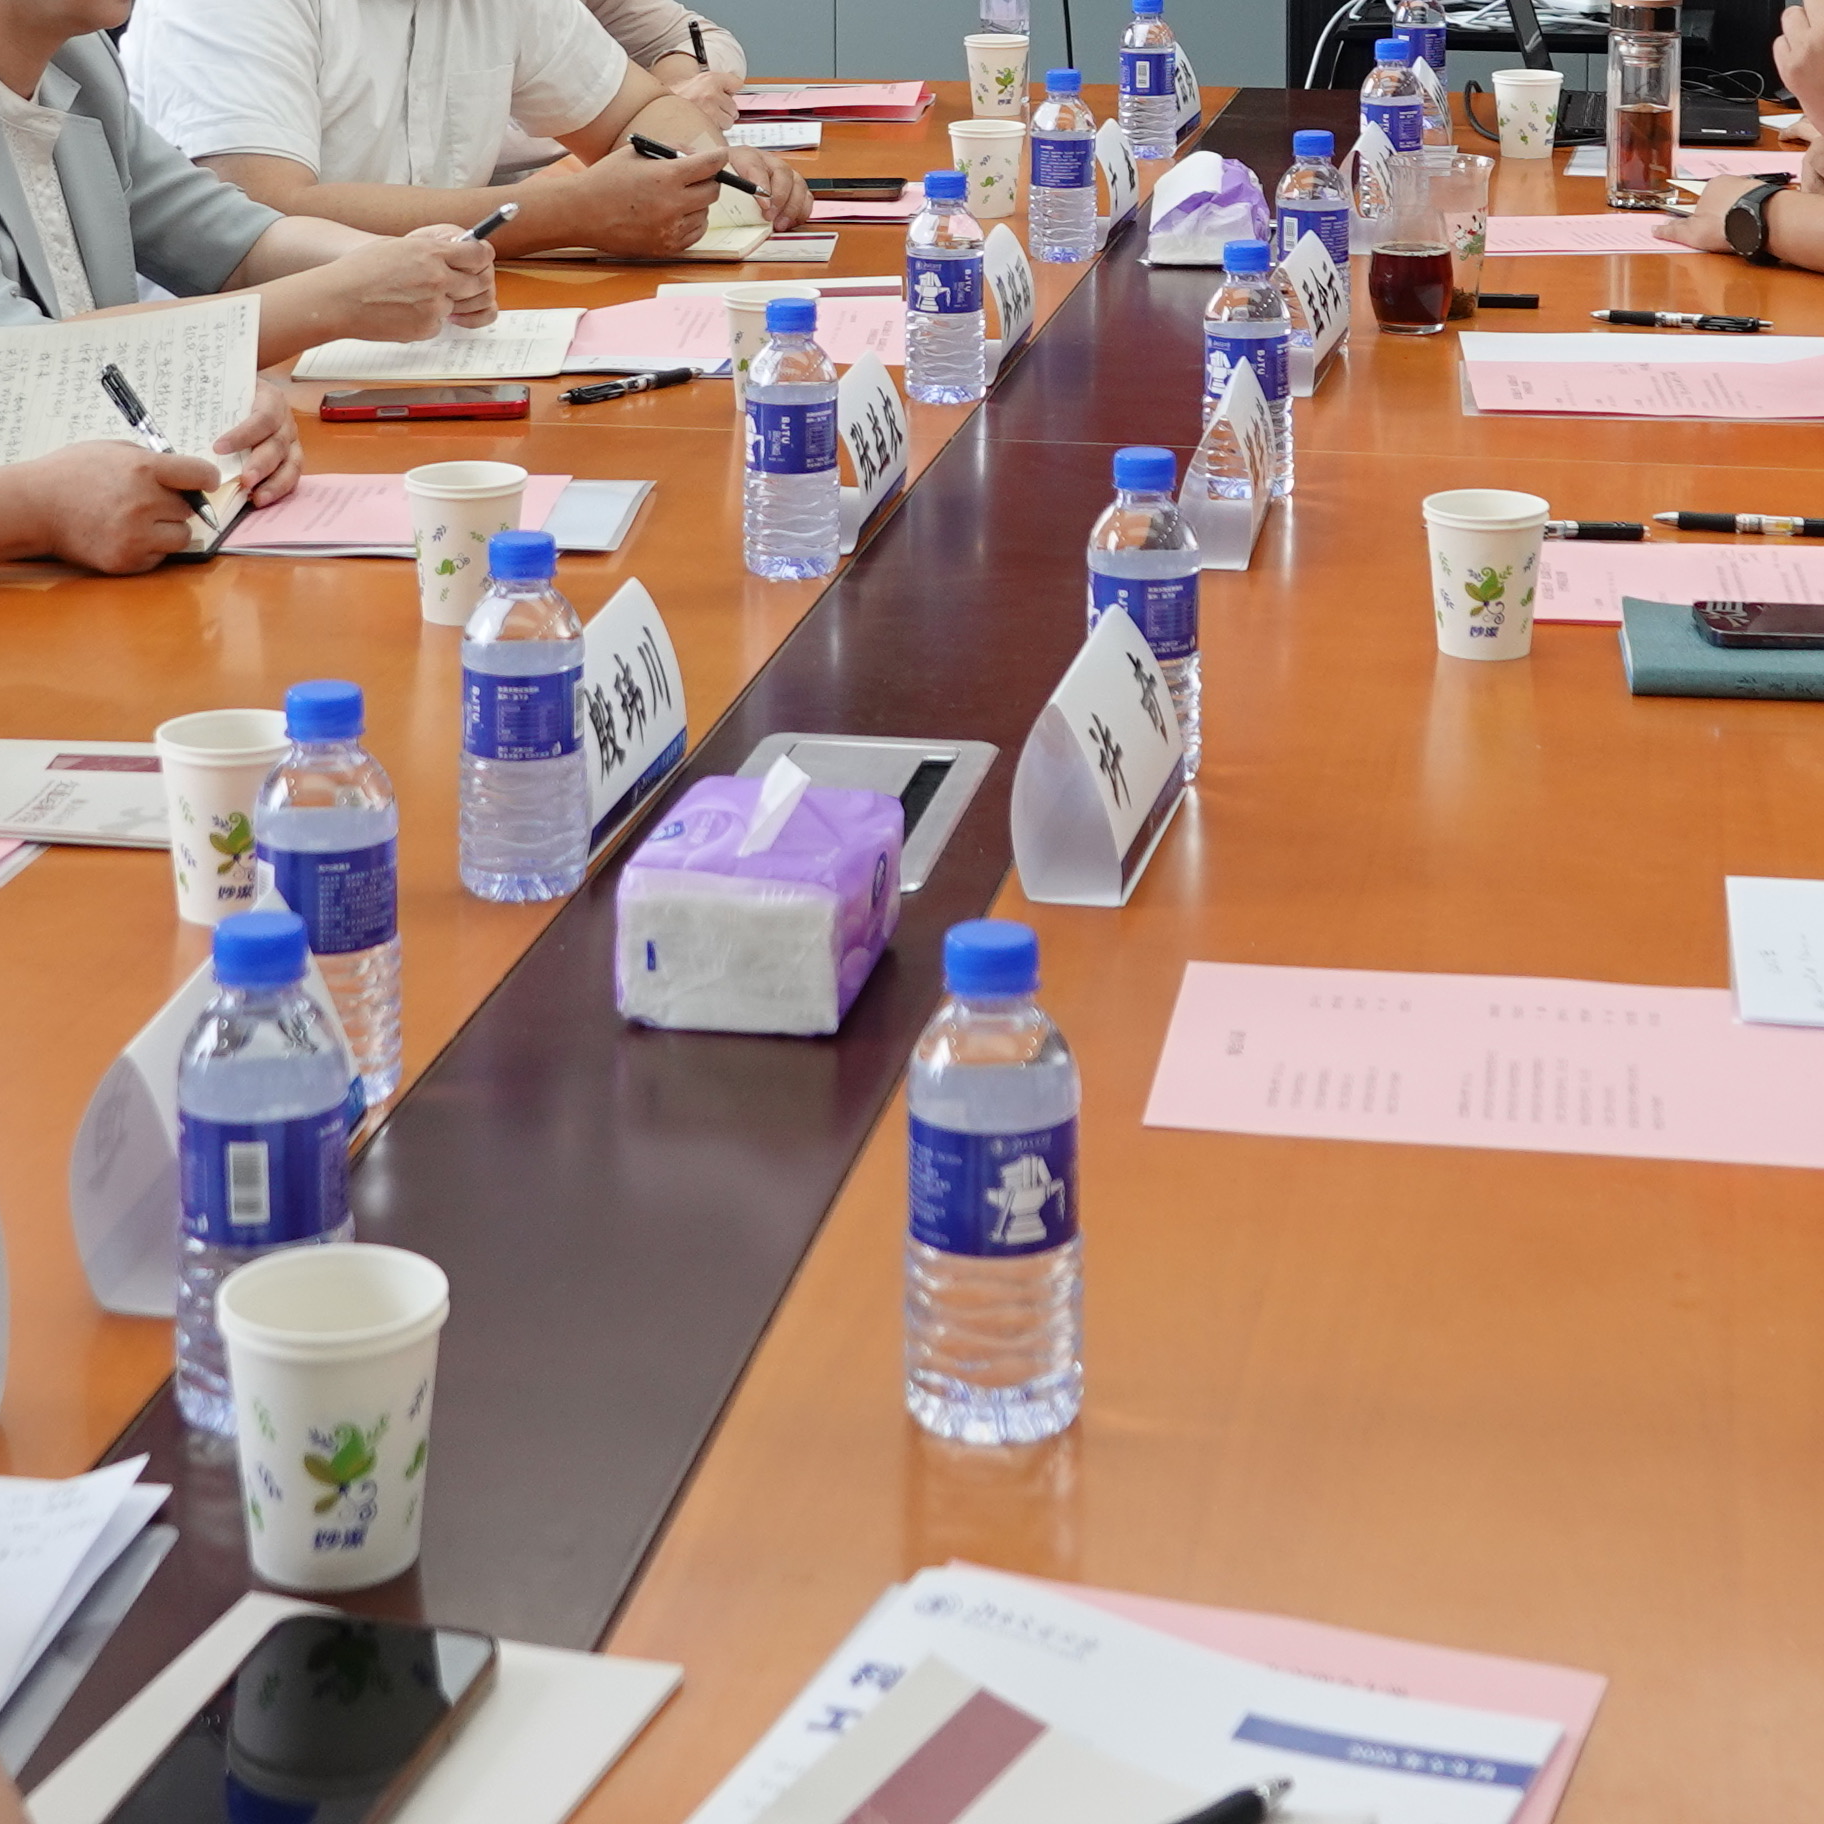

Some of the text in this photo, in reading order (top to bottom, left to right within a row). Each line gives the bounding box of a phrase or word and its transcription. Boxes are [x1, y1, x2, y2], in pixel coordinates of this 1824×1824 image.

[964, 268, 972, 293] BJTU
[1256, 349, 1266, 376] BJTU
[781, 416, 791, 445] BJTU
[850, 383, 903, 495] 张益农
[471, 685, 481, 724] BJTU
[584, 625, 672, 786] 殷玮川
